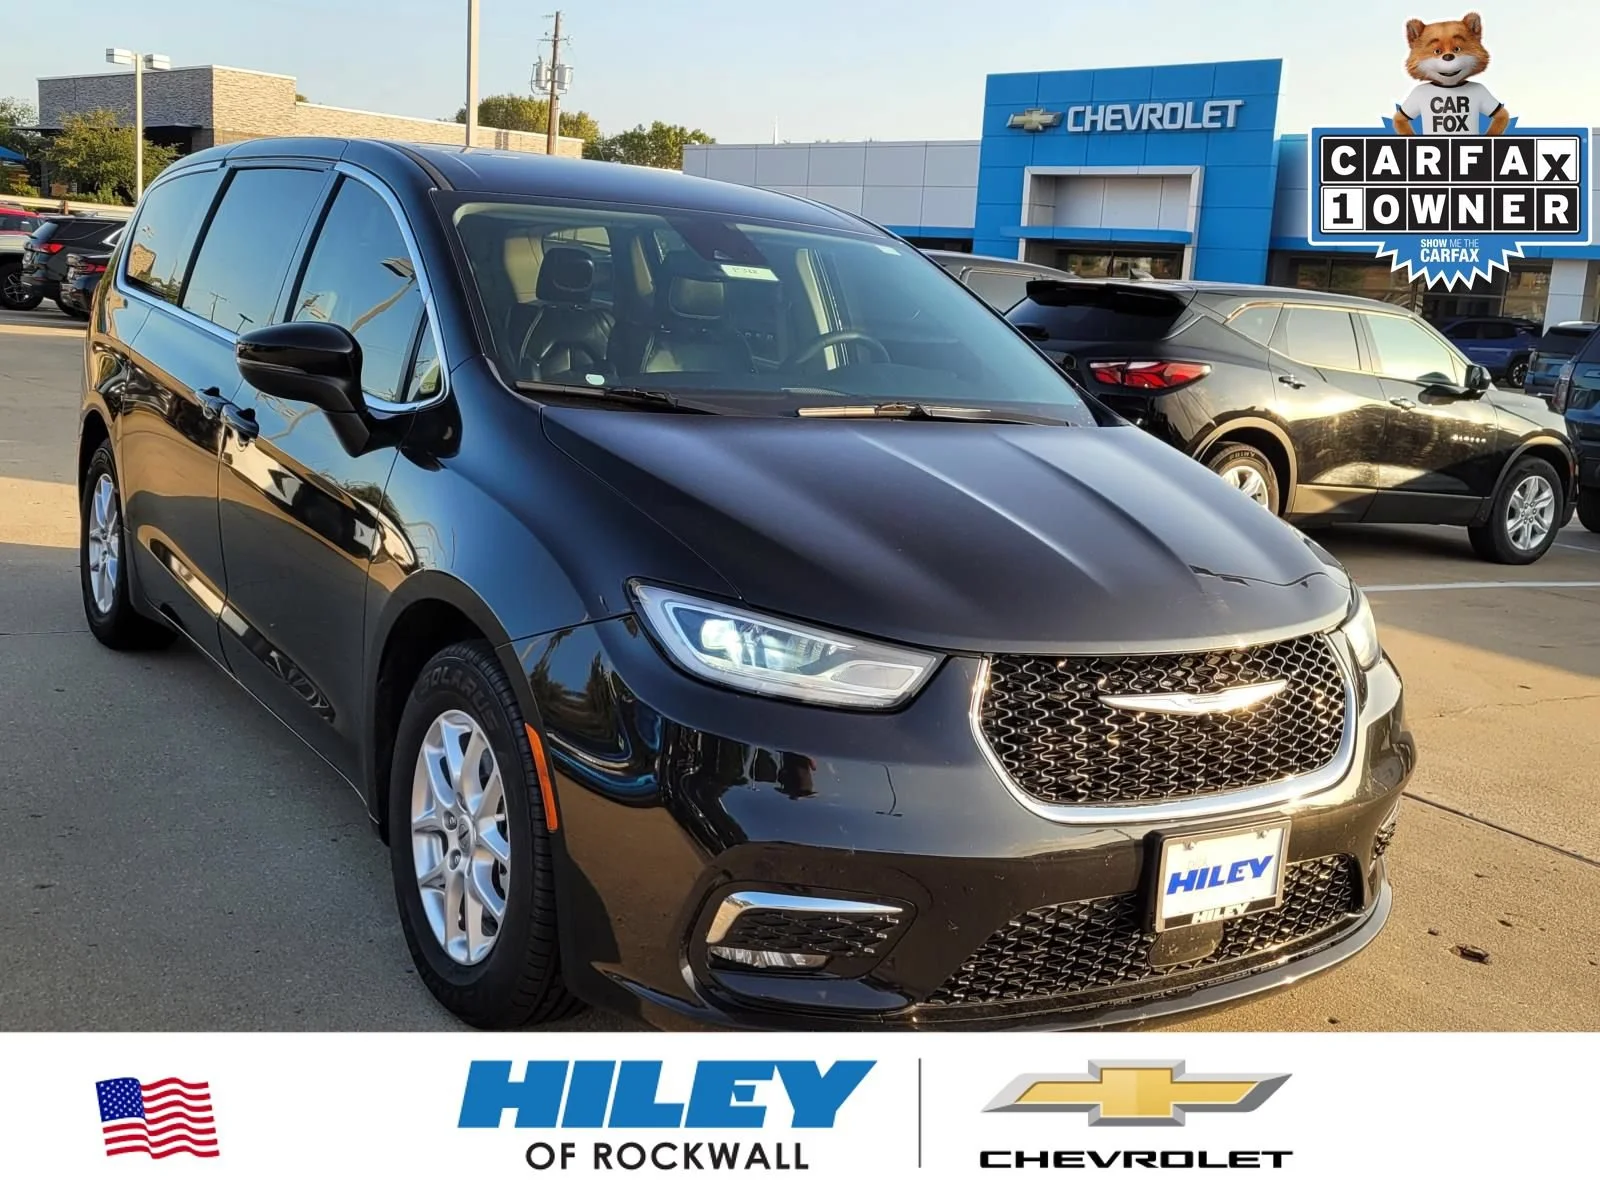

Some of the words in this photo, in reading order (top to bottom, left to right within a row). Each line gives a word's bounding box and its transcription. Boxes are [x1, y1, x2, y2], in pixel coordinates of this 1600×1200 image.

[1067, 99, 1245, 133] CHEVROLET
[1166, 854, 1274, 895] HILEY
[1191, 902, 1250, 925] HILEY
